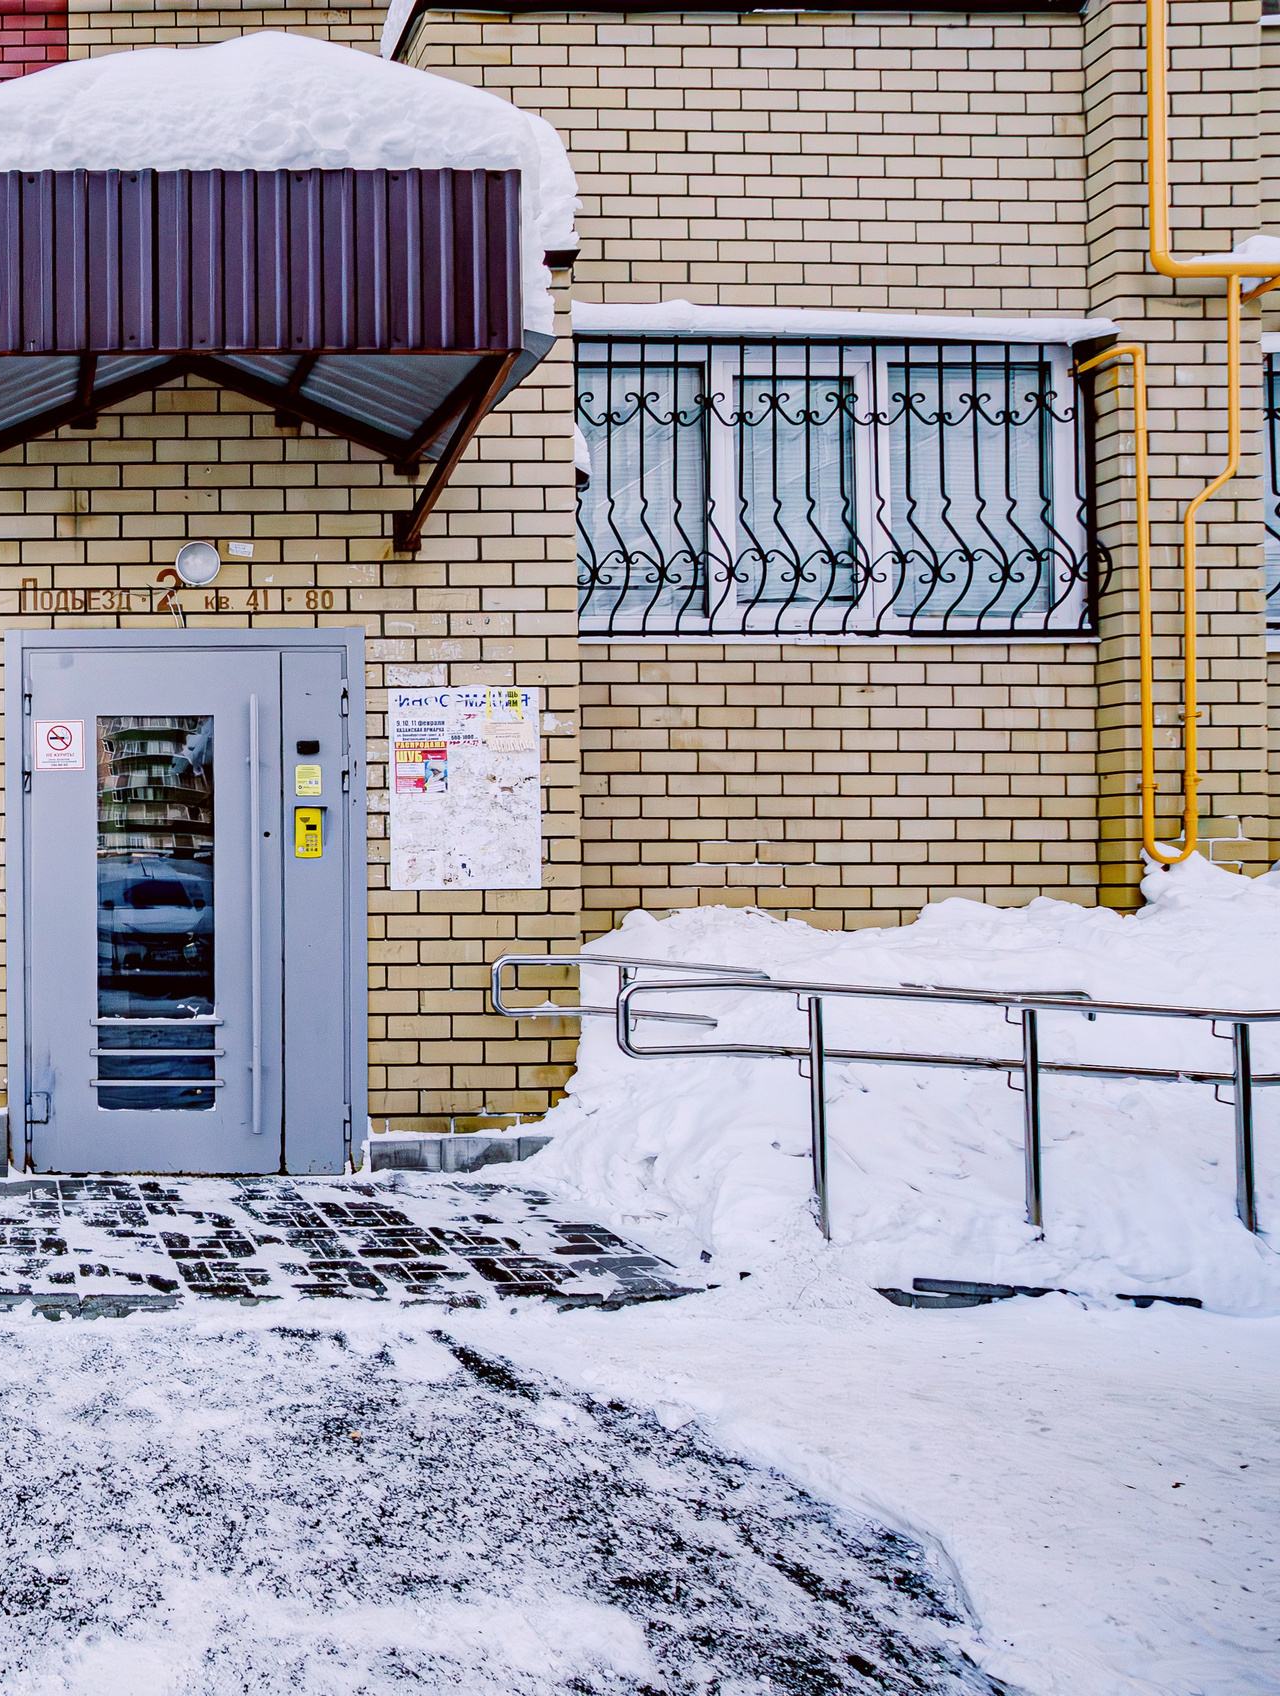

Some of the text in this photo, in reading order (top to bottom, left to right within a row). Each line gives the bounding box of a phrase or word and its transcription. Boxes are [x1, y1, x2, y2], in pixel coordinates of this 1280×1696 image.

[156, 568, 184, 611] 2
[246, 590, 269, 610] 41
[305, 590, 333, 610] 80
[396, 751, 423, 763] ШУБ
